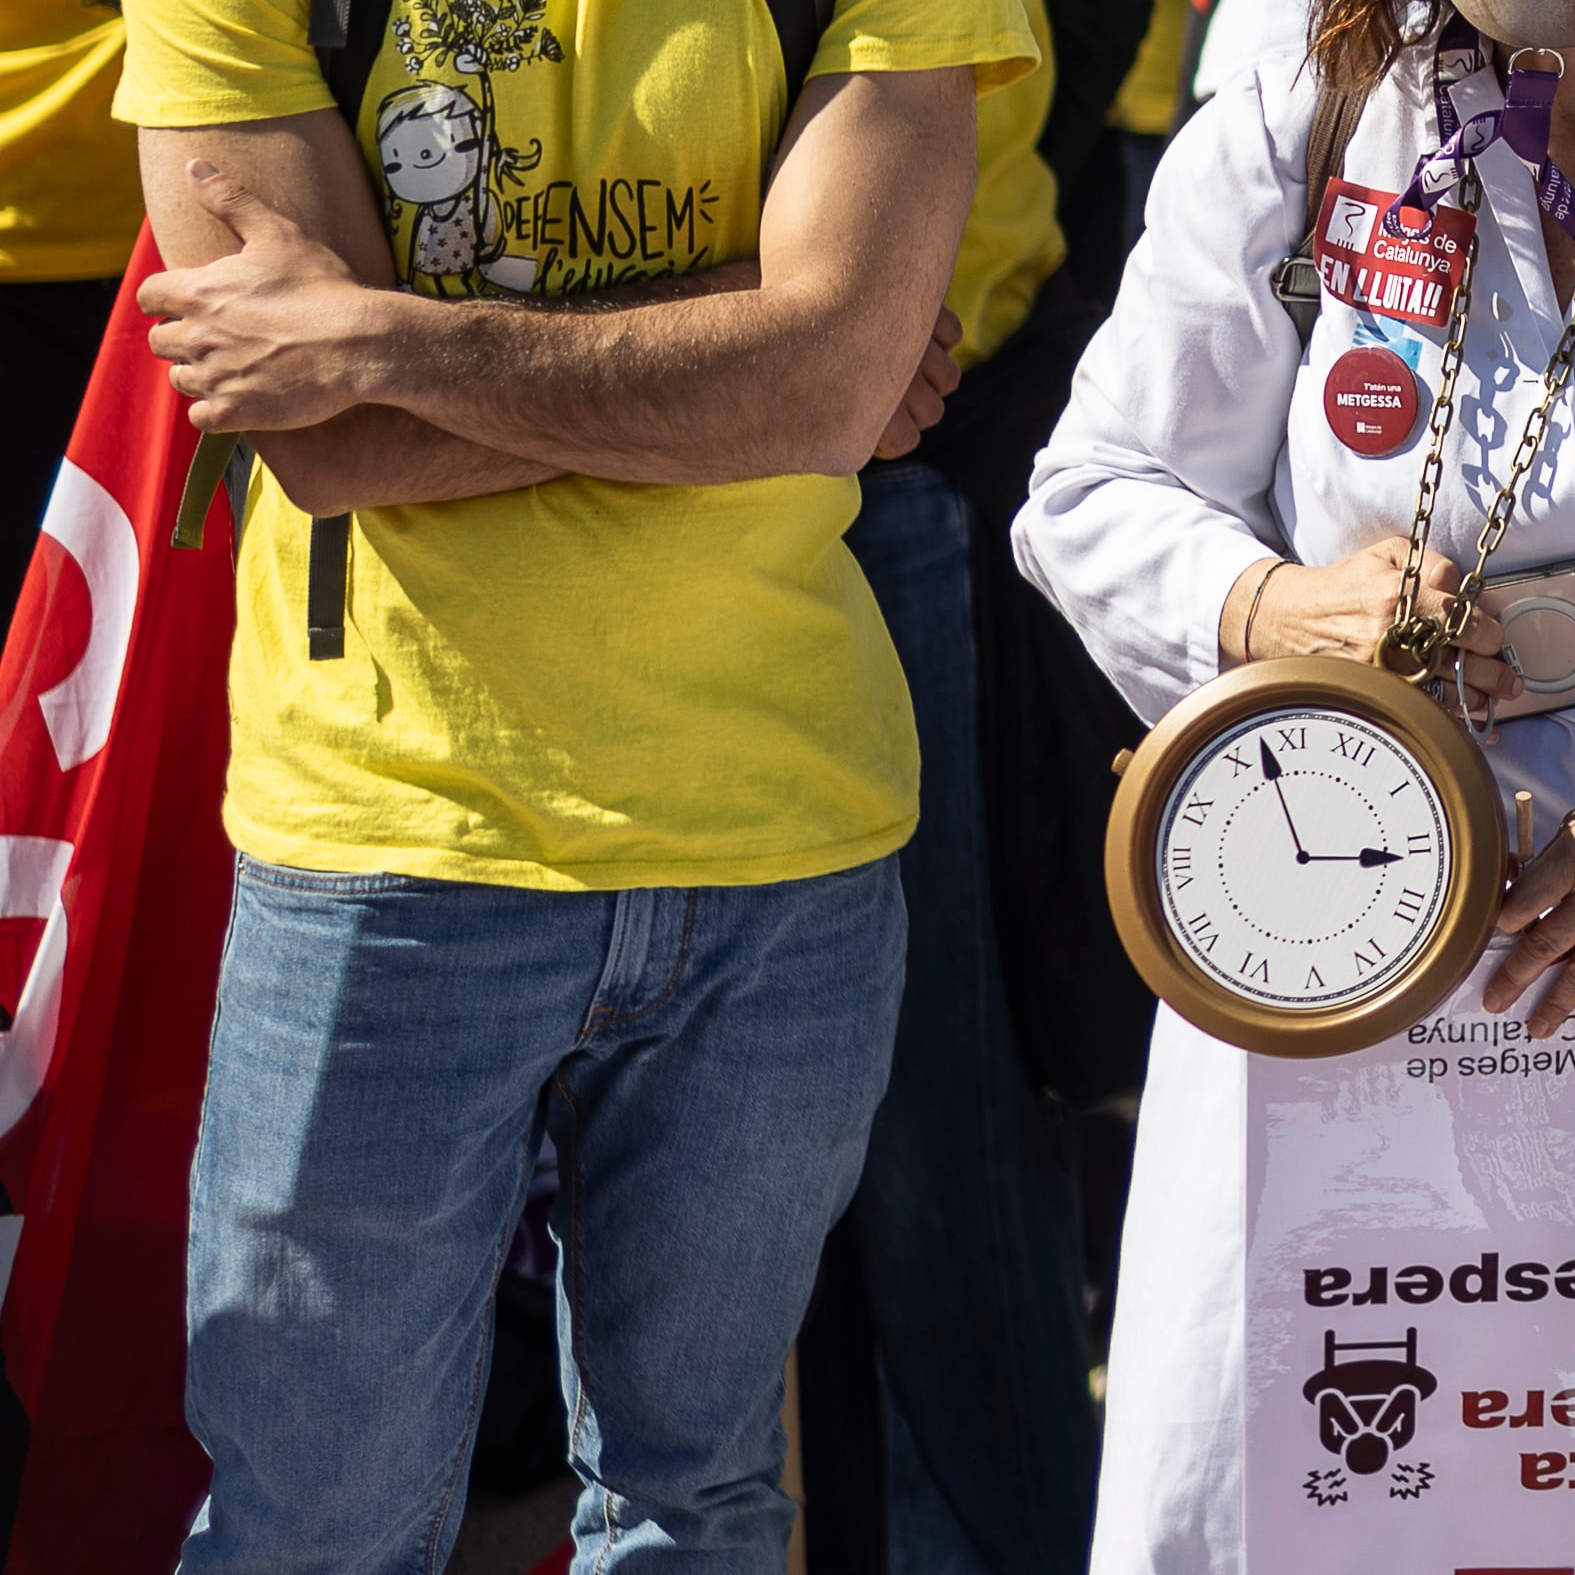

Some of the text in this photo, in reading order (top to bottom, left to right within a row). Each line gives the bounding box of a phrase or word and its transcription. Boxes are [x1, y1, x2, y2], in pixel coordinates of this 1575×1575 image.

[503, 178, 695, 261] DEFENSEM
[1373, 240, 1451, 274] Catalunya
[1434, 234, 1458, 254] de
[1320, 254, 1443, 317] EN LLUITA!!
[1337, 394, 1402, 408] METGESSA
[1277, 728, 1307, 752] XI
[1330, 732, 1377, 768] XII
[1222, 746, 1253, 778] X
[1389, 780, 1411, 798] I
[1182, 792, 1215, 828] IX
[1407, 833, 1432, 857] II
[1172, 847, 1194, 890] VIII
[1392, 887, 1426, 924] III
[1188, 913, 1220, 953] VII
[1239, 952, 1271, 983] VI
[1353, 938, 1388, 976] IV
[1304, 965, 1326, 990] V
[1407, 1058, 1448, 1083] de
